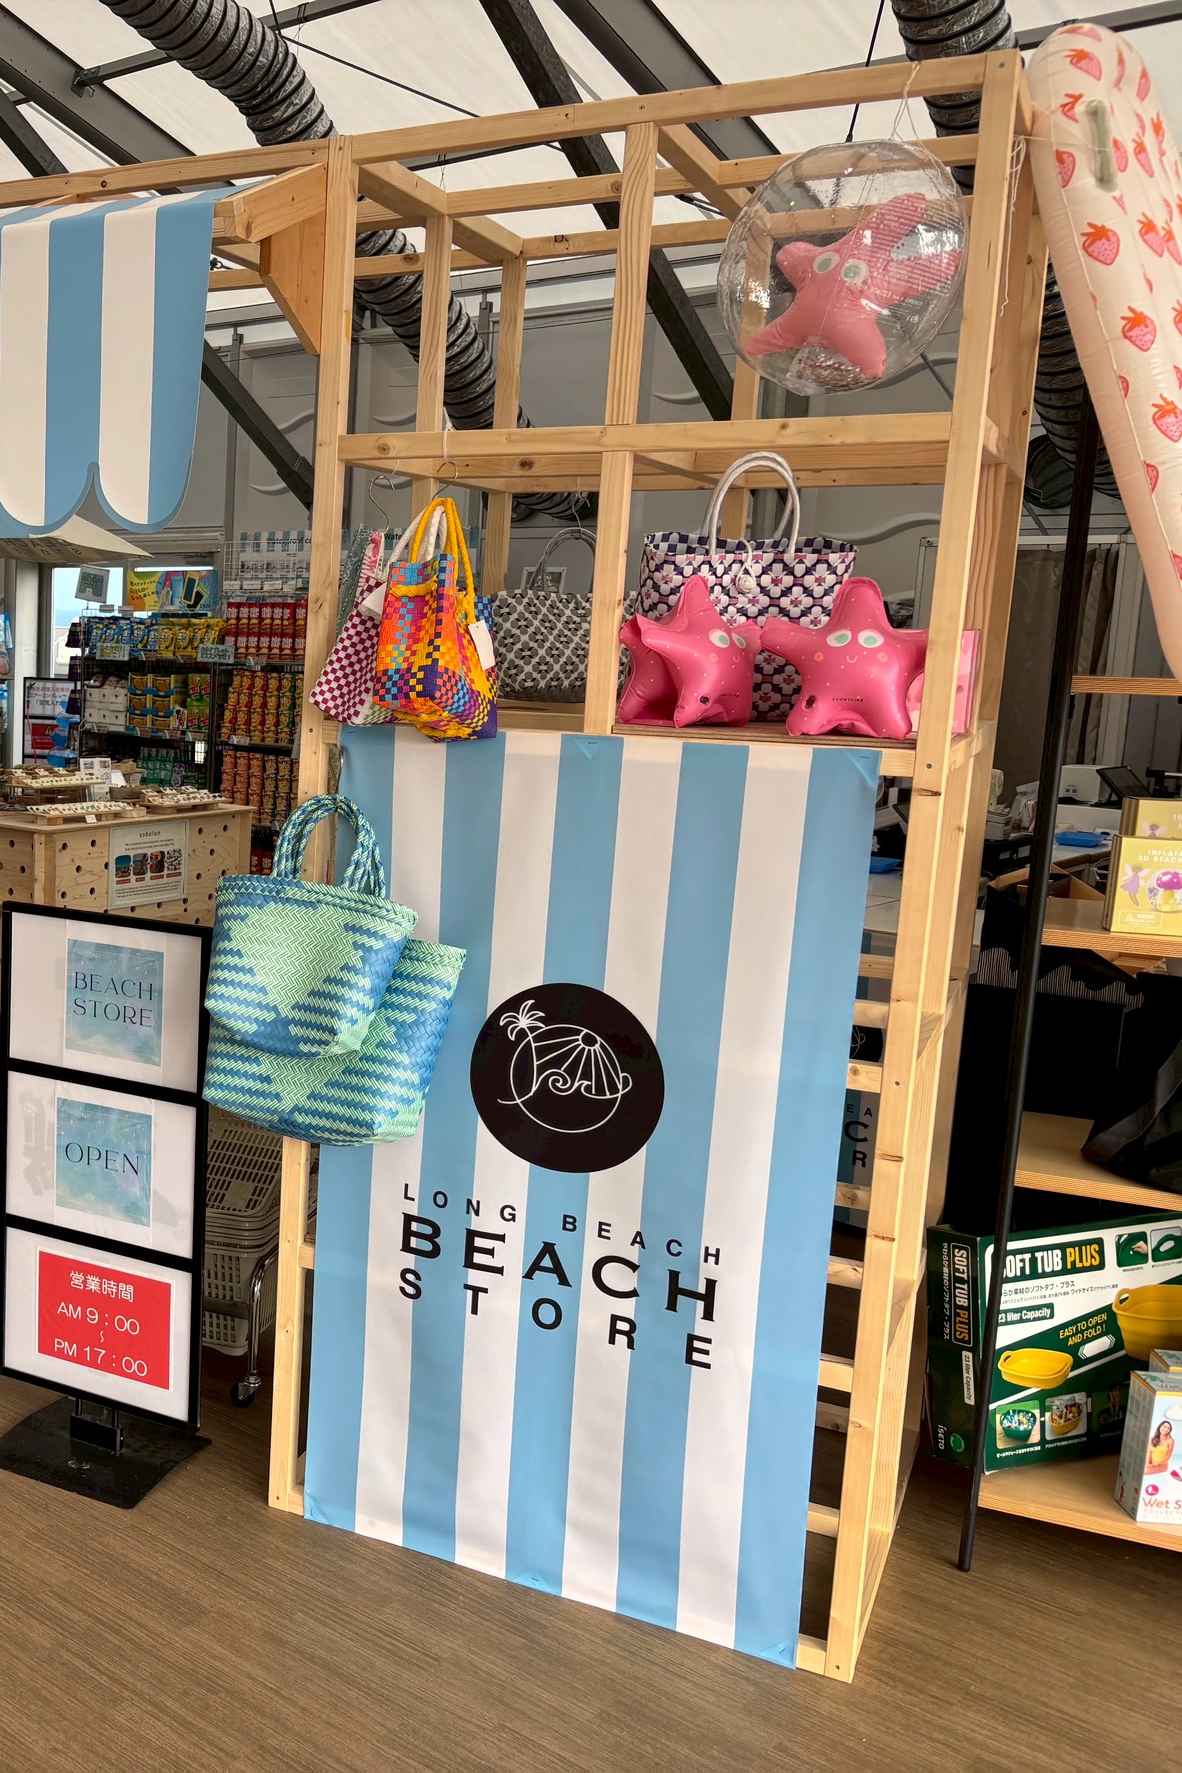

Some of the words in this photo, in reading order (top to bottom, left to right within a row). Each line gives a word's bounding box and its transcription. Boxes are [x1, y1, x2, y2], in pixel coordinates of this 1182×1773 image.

[74, 971, 154, 1001] BEACH
[73, 998, 153, 1028] STORE
[65, 1142, 140, 1176] OPEN
[403, 1183, 517, 1223] LONG
[561, 1214, 721, 1266] BEACH
[399, 1212, 718, 1322] BEACH
[954, 1248, 968, 1278] SOFT
[1002, 1252, 1032, 1278] OFT
[1035, 1249, 1062, 1273] TUB
[1066, 1243, 1100, 1270] PLUS
[69, 1270, 134, 1303] 営業時間
[955, 1282, 969, 1306] TUB
[1002, 1280, 1075, 1297] らか素材のソフトタブ・プラス
[57, 1301, 82, 1320] AM
[398, 1267, 712, 1370] STORE
[955, 1309, 969, 1341] PLUS
[1022, 1307, 1051, 1321] Capacity
[1059, 1326, 1077, 1340] EASY
[1077, 1321, 1087, 1332] TO
[1088, 1313, 1108, 1328] OPEN
[1068, 1335, 1083, 1347] AND
[54, 1338, 77, 1357] PM
[1142, 1497, 1171, 1509] Wet
